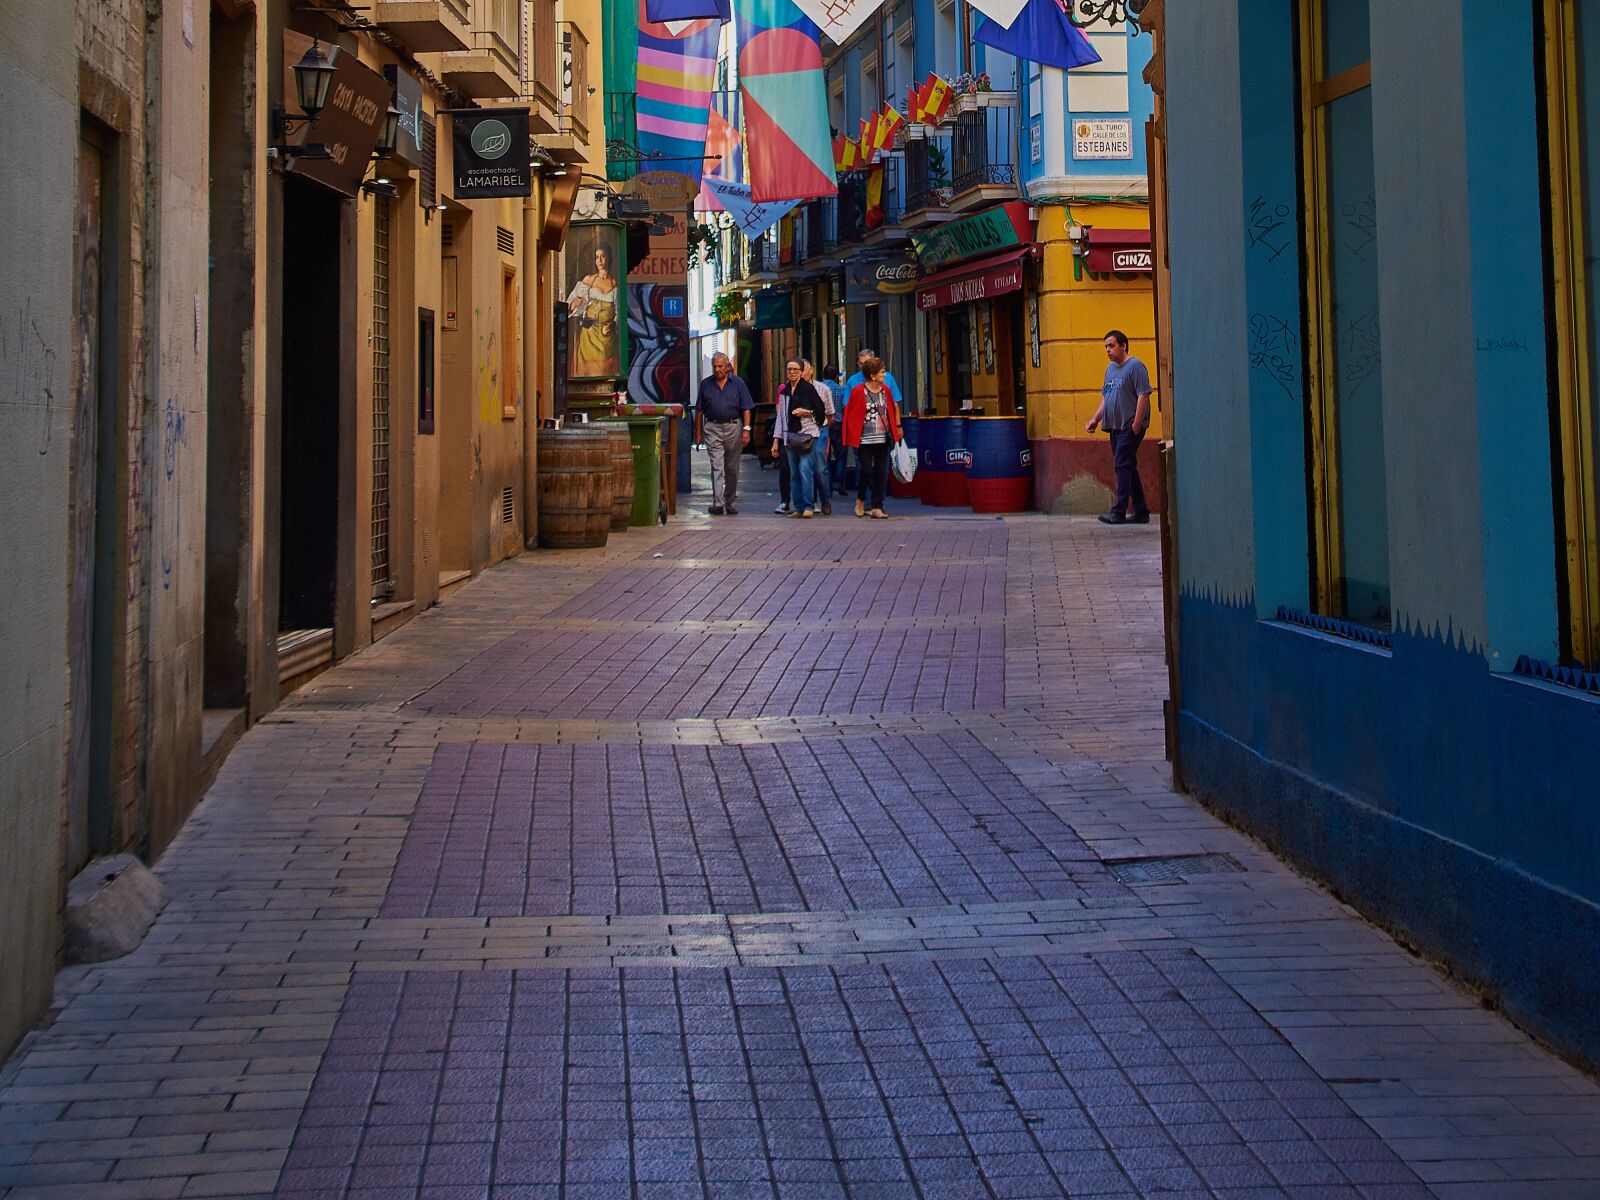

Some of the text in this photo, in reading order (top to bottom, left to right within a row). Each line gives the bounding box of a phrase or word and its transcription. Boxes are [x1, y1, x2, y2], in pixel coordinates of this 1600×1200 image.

[1078, 141, 1128, 153] ESTEBANES
[459, 175, 525, 188] LAMARIBEL
[1117, 253, 1151, 267] CINZA
[669, 299, 677, 311] R
